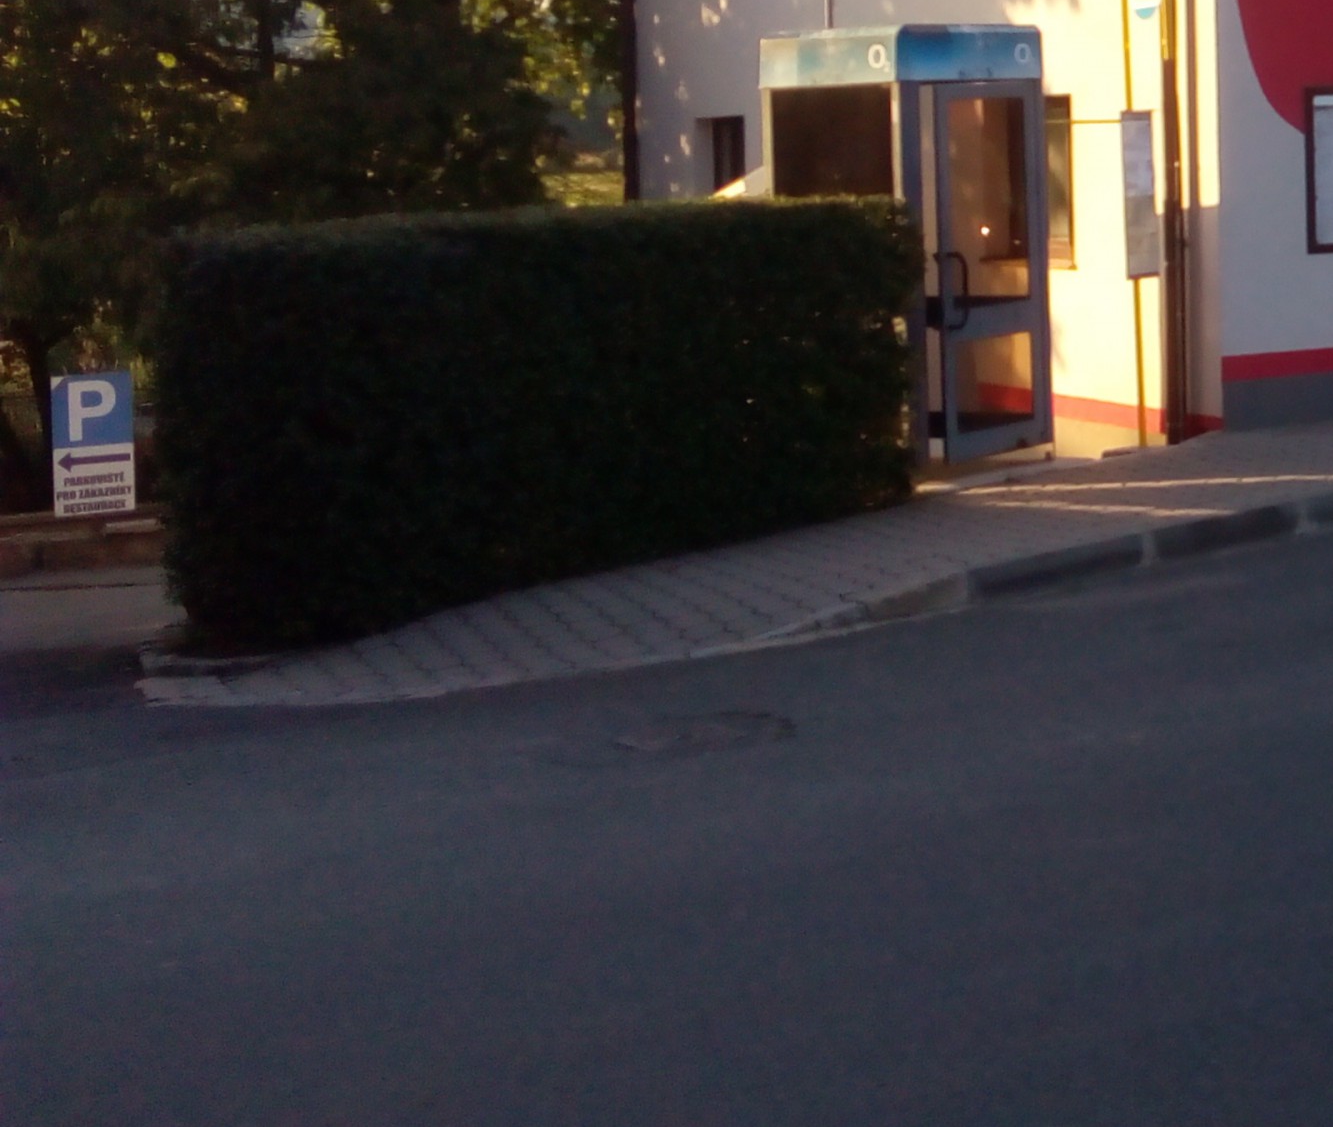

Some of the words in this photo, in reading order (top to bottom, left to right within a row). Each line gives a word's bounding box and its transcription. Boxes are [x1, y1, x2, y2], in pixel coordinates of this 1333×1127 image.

[68, 380, 116, 441] P
[56, 490, 76, 502] PRO
[63, 499, 126, 514] RESTAURACE
